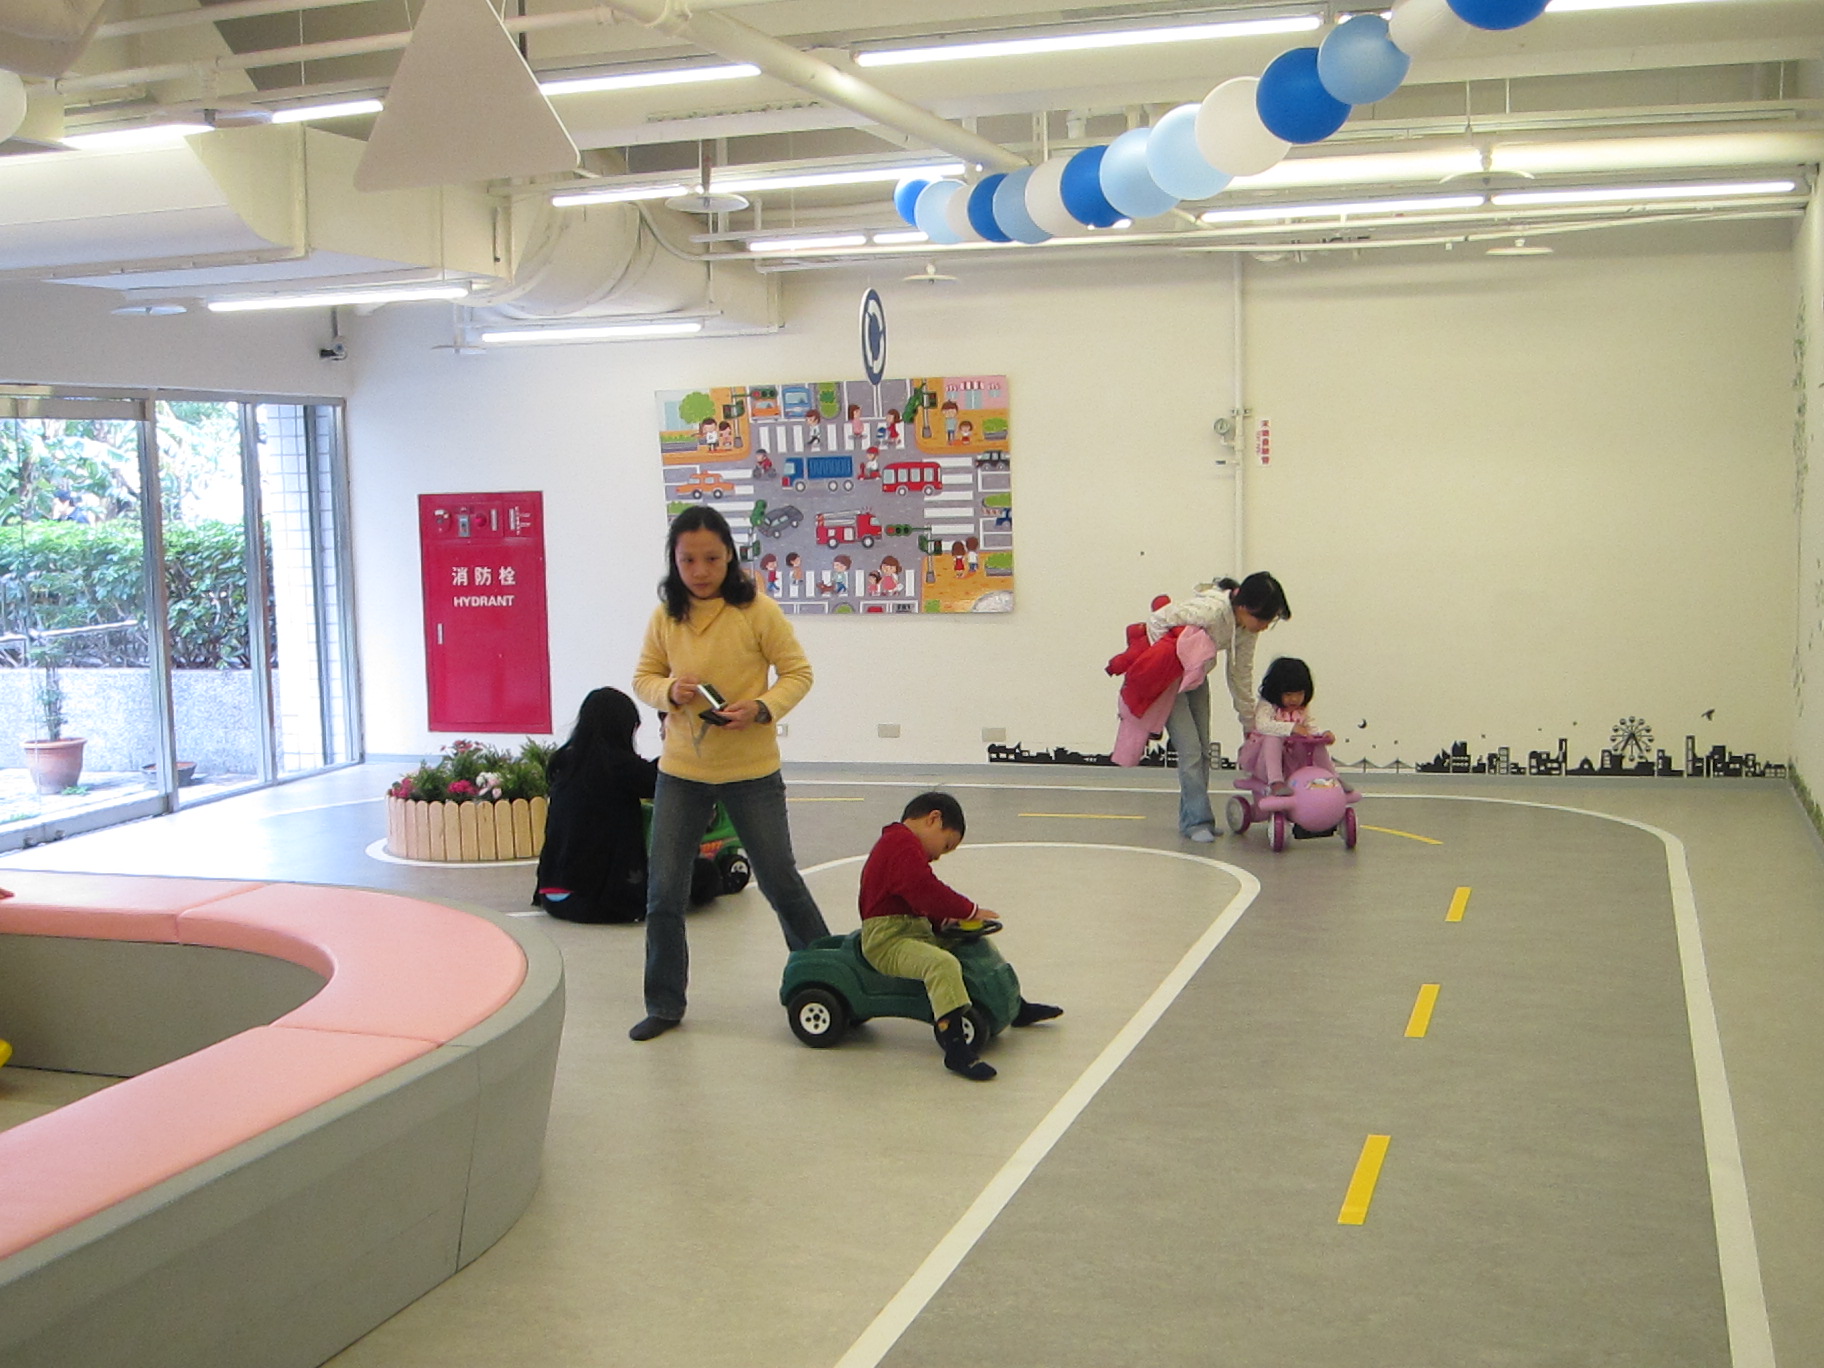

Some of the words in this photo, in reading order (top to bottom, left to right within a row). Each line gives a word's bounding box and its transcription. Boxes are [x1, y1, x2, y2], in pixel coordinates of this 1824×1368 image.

[451, 566, 516, 586] 消防栓
[453, 595, 515, 608] HYDRANT
